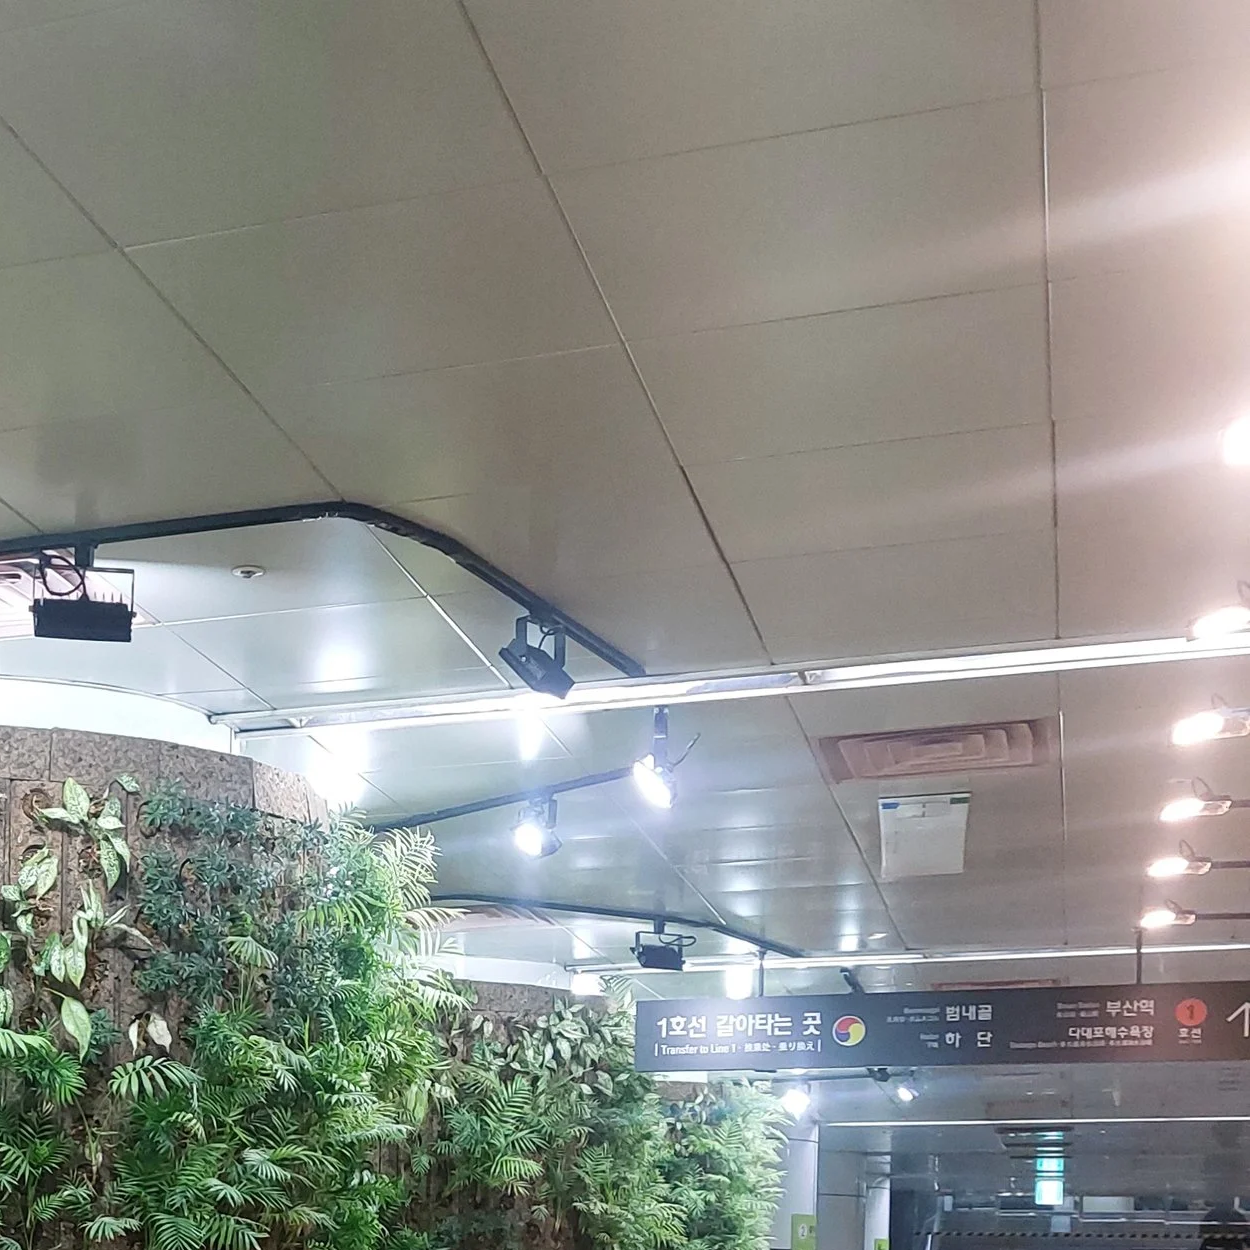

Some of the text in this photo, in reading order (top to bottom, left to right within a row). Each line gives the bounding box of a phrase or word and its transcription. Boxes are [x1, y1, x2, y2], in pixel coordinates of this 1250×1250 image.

[946, 1004, 992, 1021] 범내골
[1106, 999, 1154, 1016] 부산역
[656, 1012, 822, 1038] 1호선 갈아타는 곳
[1068, 1025, 1154, 1039] 다대포해수욕장
[1178, 1028, 1202, 1038] 호선
[661, 1042, 698, 1055] Transfer
[699, 1044, 709, 1054] to
[710, 1043, 729, 1053] Line
